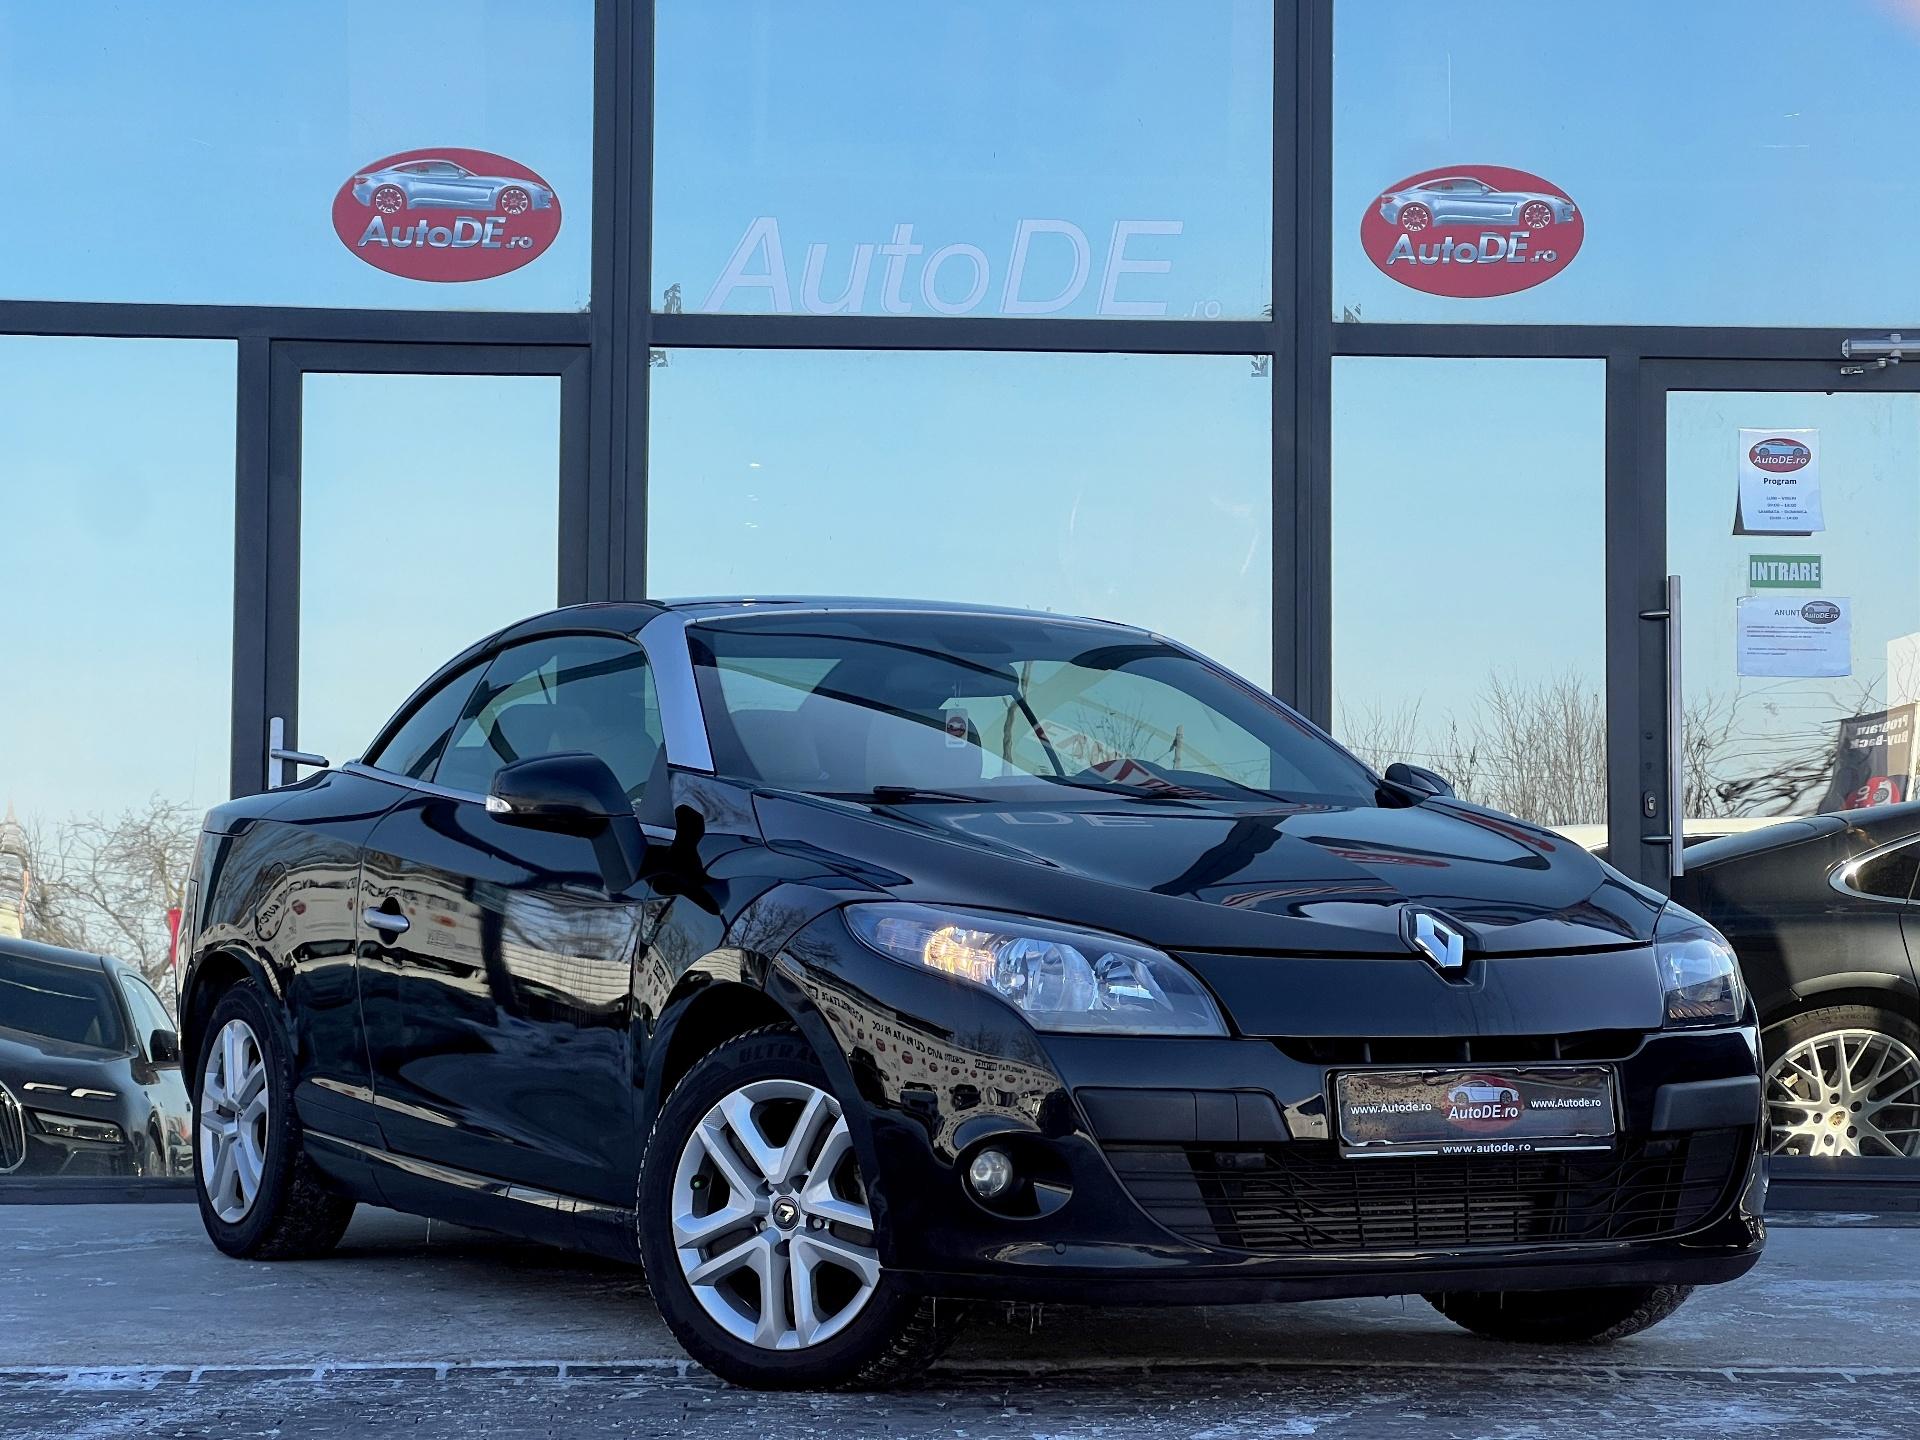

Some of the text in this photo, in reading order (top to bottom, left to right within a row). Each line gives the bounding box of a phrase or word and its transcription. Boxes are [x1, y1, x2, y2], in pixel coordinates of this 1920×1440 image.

[1753, 455, 1807, 465] AutoDE.ro
[1763, 477, 1797, 486] Program
[1751, 561, 1820, 581] INTRARE
[1350, 1102, 1432, 1115] www.Autode.ro
[1531, 1098, 1602, 1109] www.Autode.ro
[1448, 1105, 1519, 1121] AutoDE.ro
[1442, 1142, 1531, 1154] www.autode.ro
